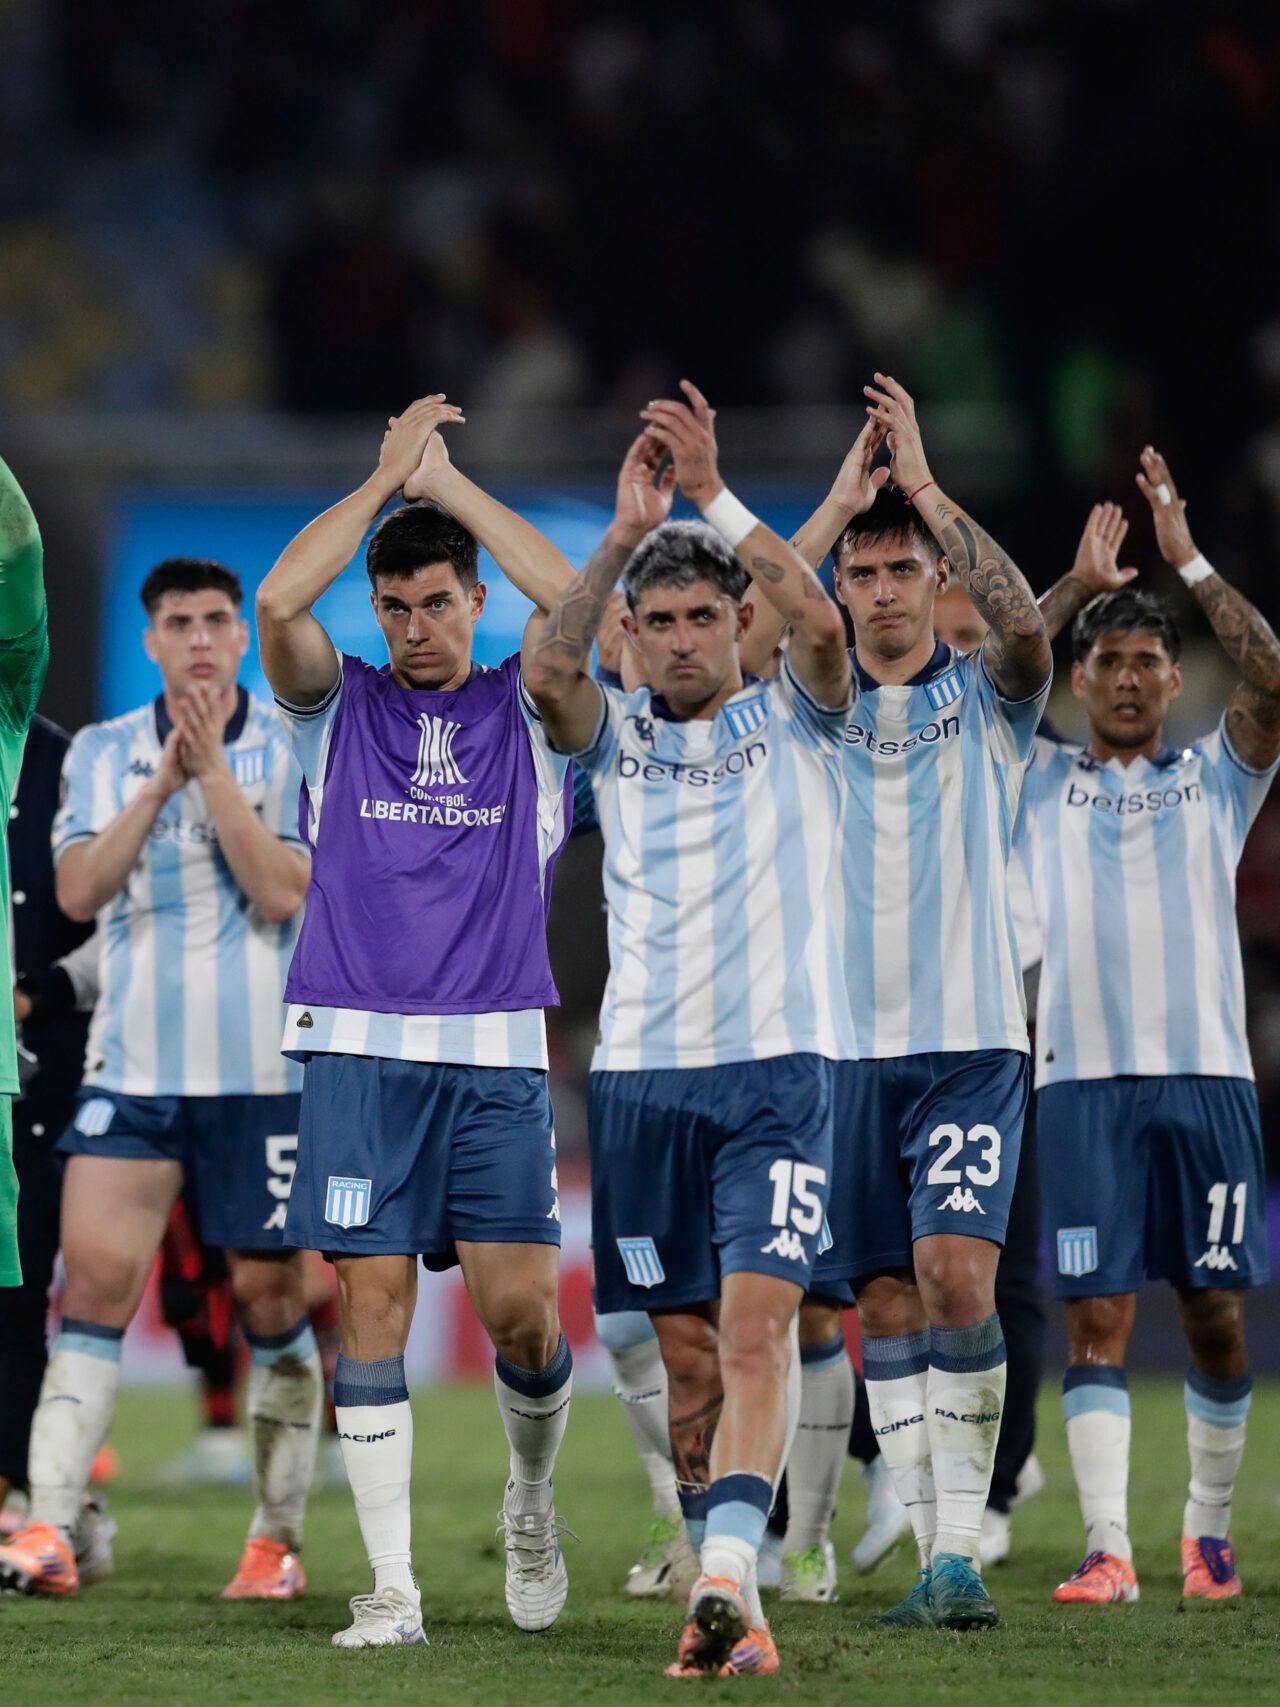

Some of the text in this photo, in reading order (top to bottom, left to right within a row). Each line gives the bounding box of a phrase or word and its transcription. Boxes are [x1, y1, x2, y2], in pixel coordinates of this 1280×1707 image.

[845, 716, 960, 756] etsson
[619, 742, 767, 787] betsson
[360, 798, 507, 827] LBERTADORE
[1066, 783, 1201, 815] betsson
[927, 1123, 1001, 1188] 23
[331, 1180, 368, 1190] RACING
[769, 1159, 826, 1236] 15
[1206, 1182, 1247, 1244] 11
[873, 1414, 924, 1436] ACING
[934, 1408, 1000, 1425] RACING
